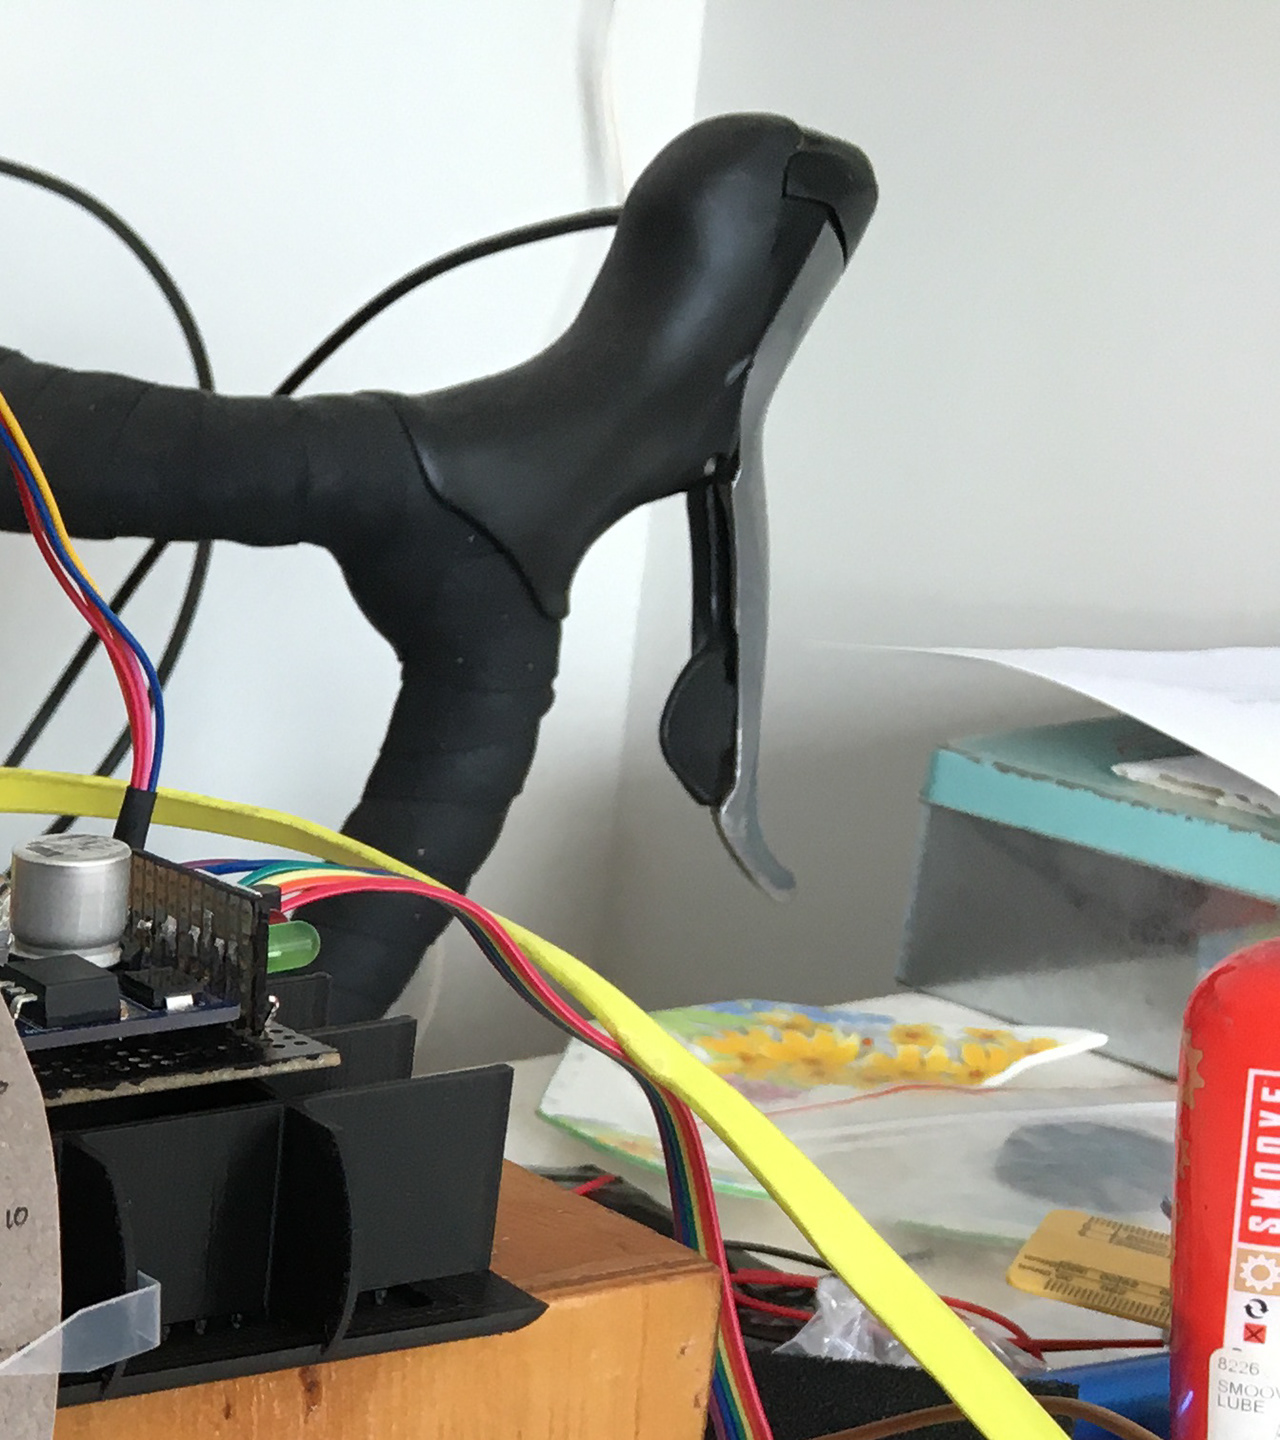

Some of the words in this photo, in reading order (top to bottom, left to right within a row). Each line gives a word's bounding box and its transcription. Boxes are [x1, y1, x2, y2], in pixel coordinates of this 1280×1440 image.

[6, 1206, 29, 1231] 10
[1217, 1356, 1261, 1377] 8226
[1217, 1393, 1265, 1414] LUBE
